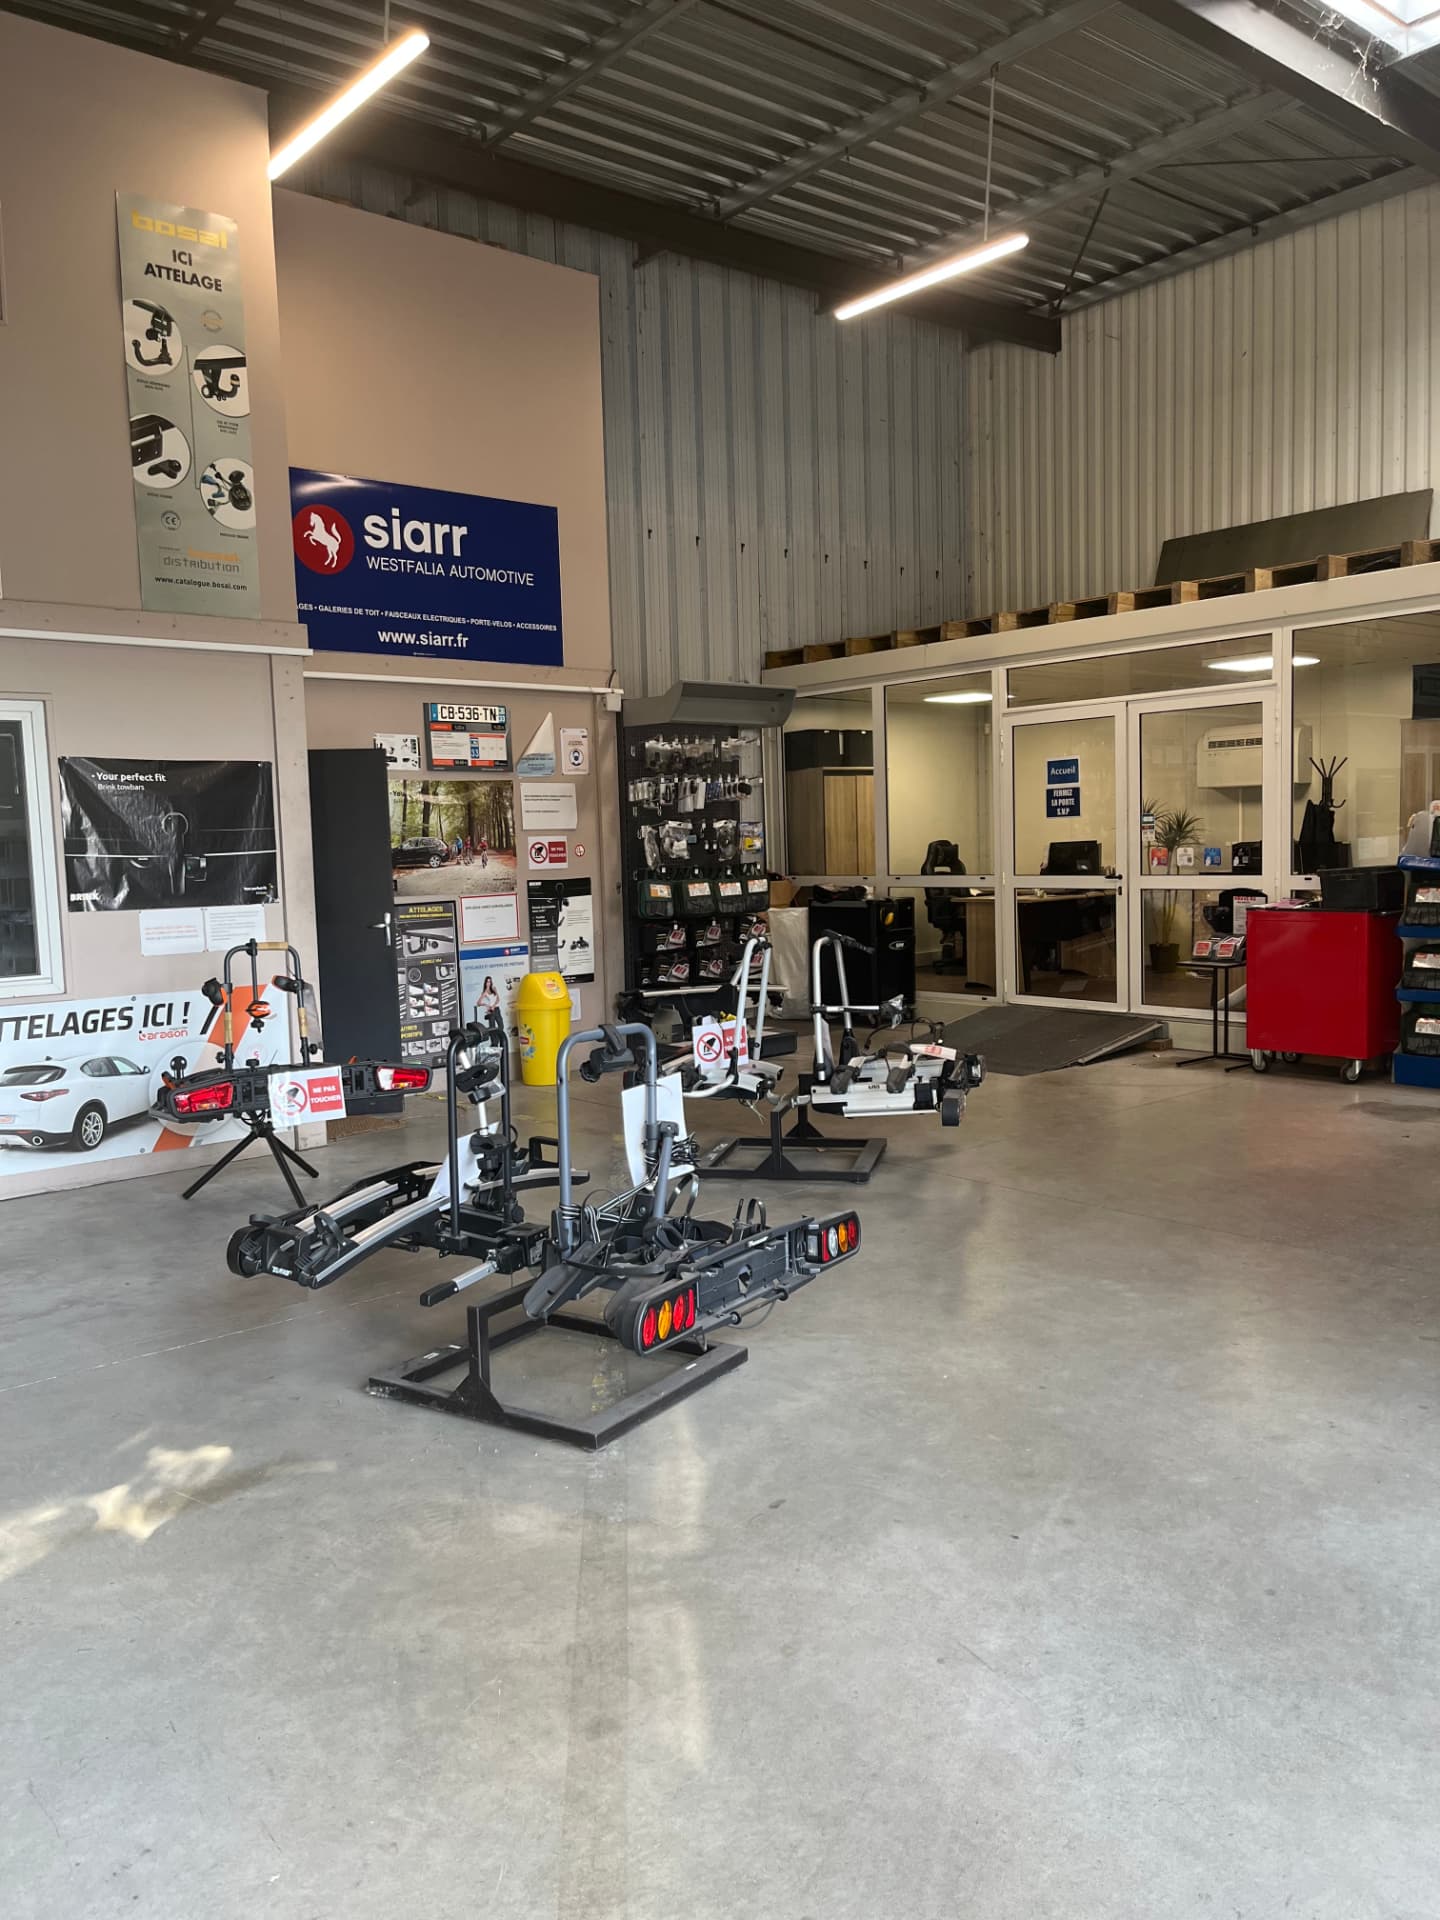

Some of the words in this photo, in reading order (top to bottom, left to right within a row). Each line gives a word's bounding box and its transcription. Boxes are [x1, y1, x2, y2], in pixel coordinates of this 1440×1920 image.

[131, 209, 228, 250] bosal
[171, 249, 193, 267] ICI
[144, 262, 223, 292] ATTELAGE
[363, 507, 468, 557] siarr
[366, 555, 445, 577] WESTFALIA
[449, 564, 534, 586] AUTOMOTIVE
[297, 602, 313, 611] GES
[318, 604, 353, 615] GALERIES
[365, 608, 380, 617] TOIT
[384, 610, 421, 621] FAISCEAUX
[422, 613, 466, 624] ELECTRIQUES
[516, 622, 557, 631] ACCESSOIRES
[377, 630, 469, 648] www.siarr.fr
[96, 772, 119, 781] Your
[120, 773, 154, 783] perfect
[154, 772, 167, 782] fit
[1051, 765, 1076, 776] Accueil
[97, 783, 115, 791] Brink
[142, 1002, 174, 1028] ICI
[182, 1001, 191, 1025] !
[311, 1094, 341, 1104] TOUCHER
